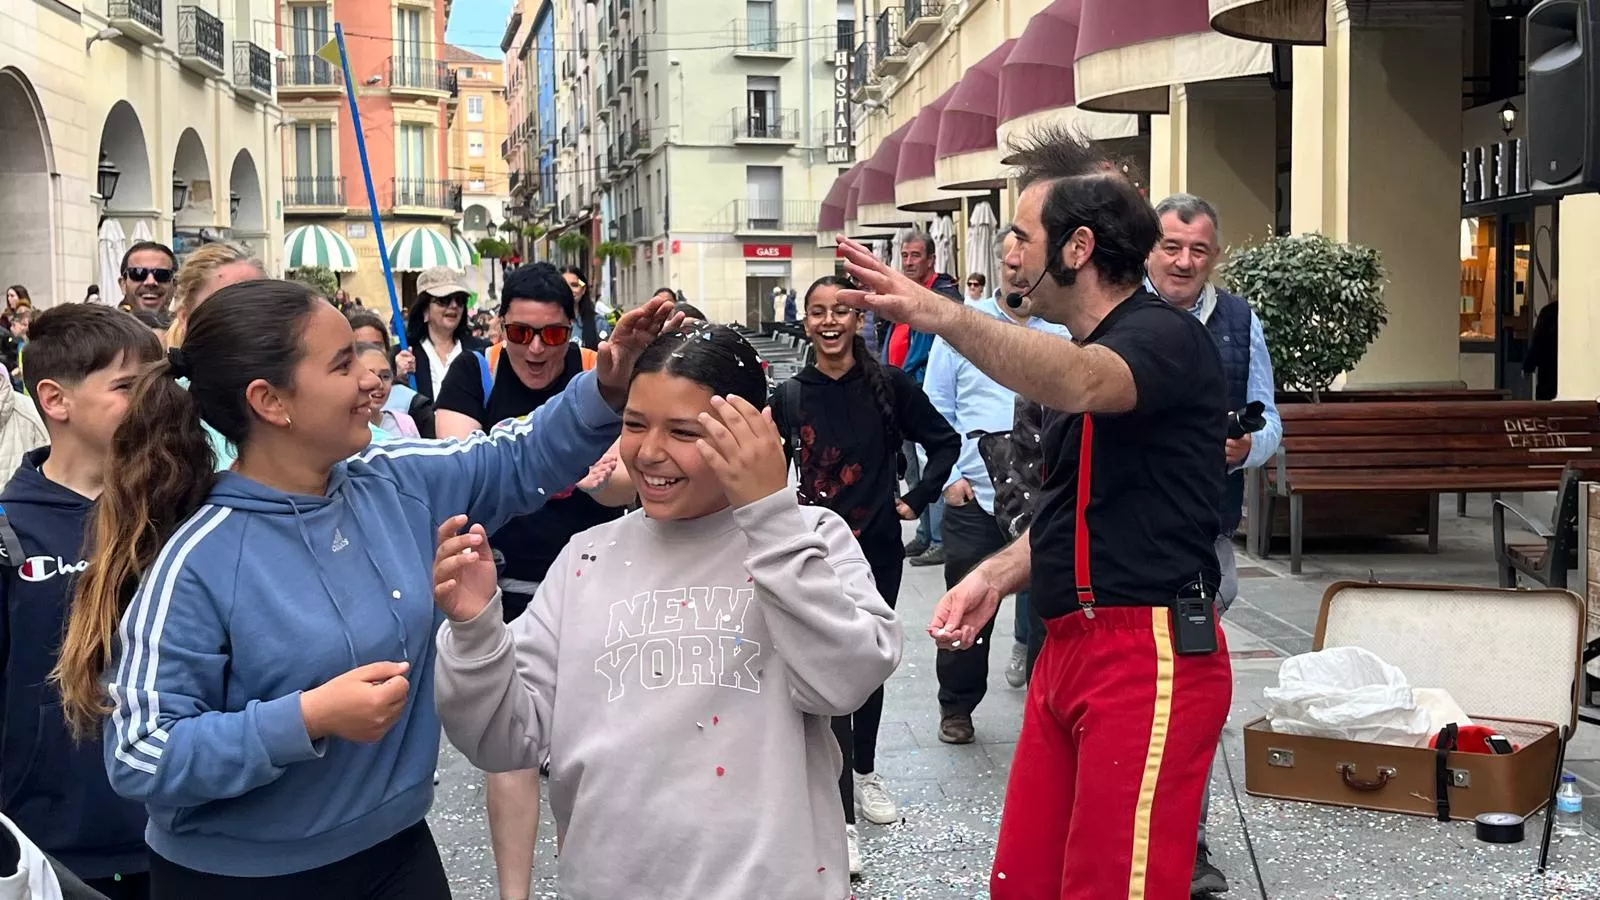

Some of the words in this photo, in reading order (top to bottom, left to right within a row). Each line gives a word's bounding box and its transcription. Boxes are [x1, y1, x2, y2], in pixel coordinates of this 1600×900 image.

[835, 51, 848, 144] HOSTAL
[756, 247, 780, 257] GAES
[1503, 418, 1560, 432] DIEGO
[605, 586, 755, 648] NEW
[595, 635, 761, 702] YORK
